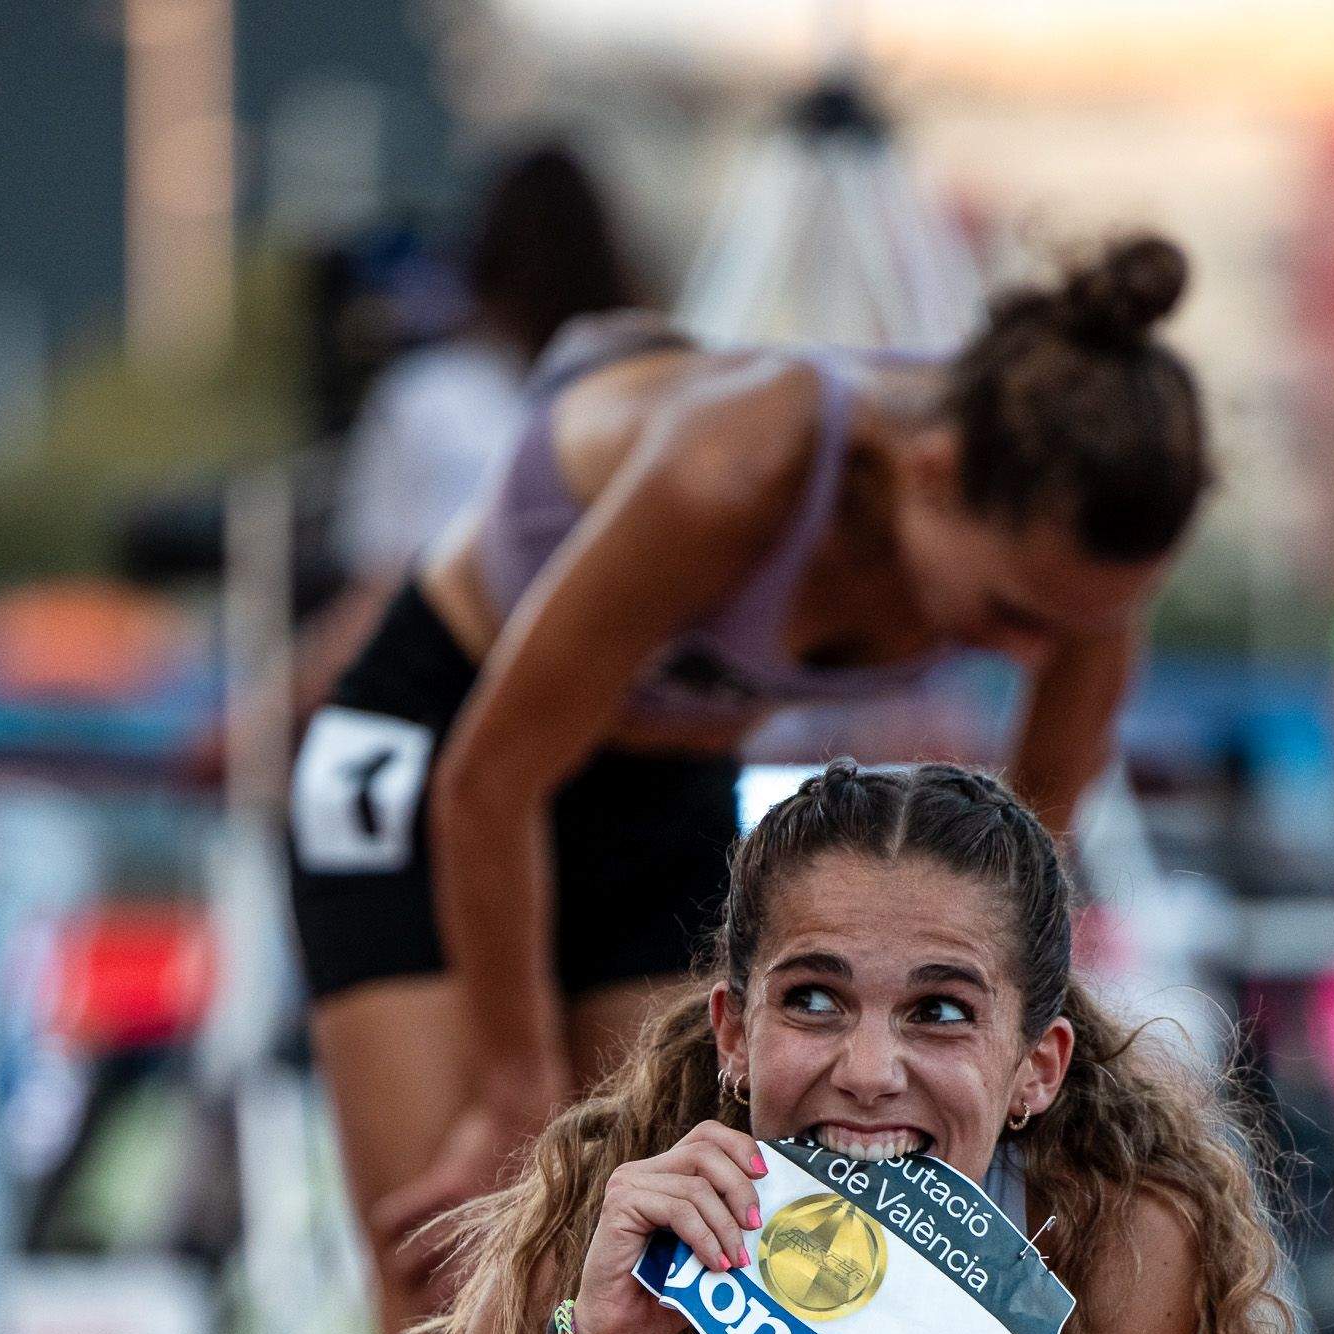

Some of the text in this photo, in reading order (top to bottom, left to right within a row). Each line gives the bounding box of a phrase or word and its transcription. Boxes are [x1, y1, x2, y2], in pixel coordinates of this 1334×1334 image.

[827, 1158, 870, 1195] de
[875, 1178, 990, 1293] València
[877, 1156, 993, 1237] putació
